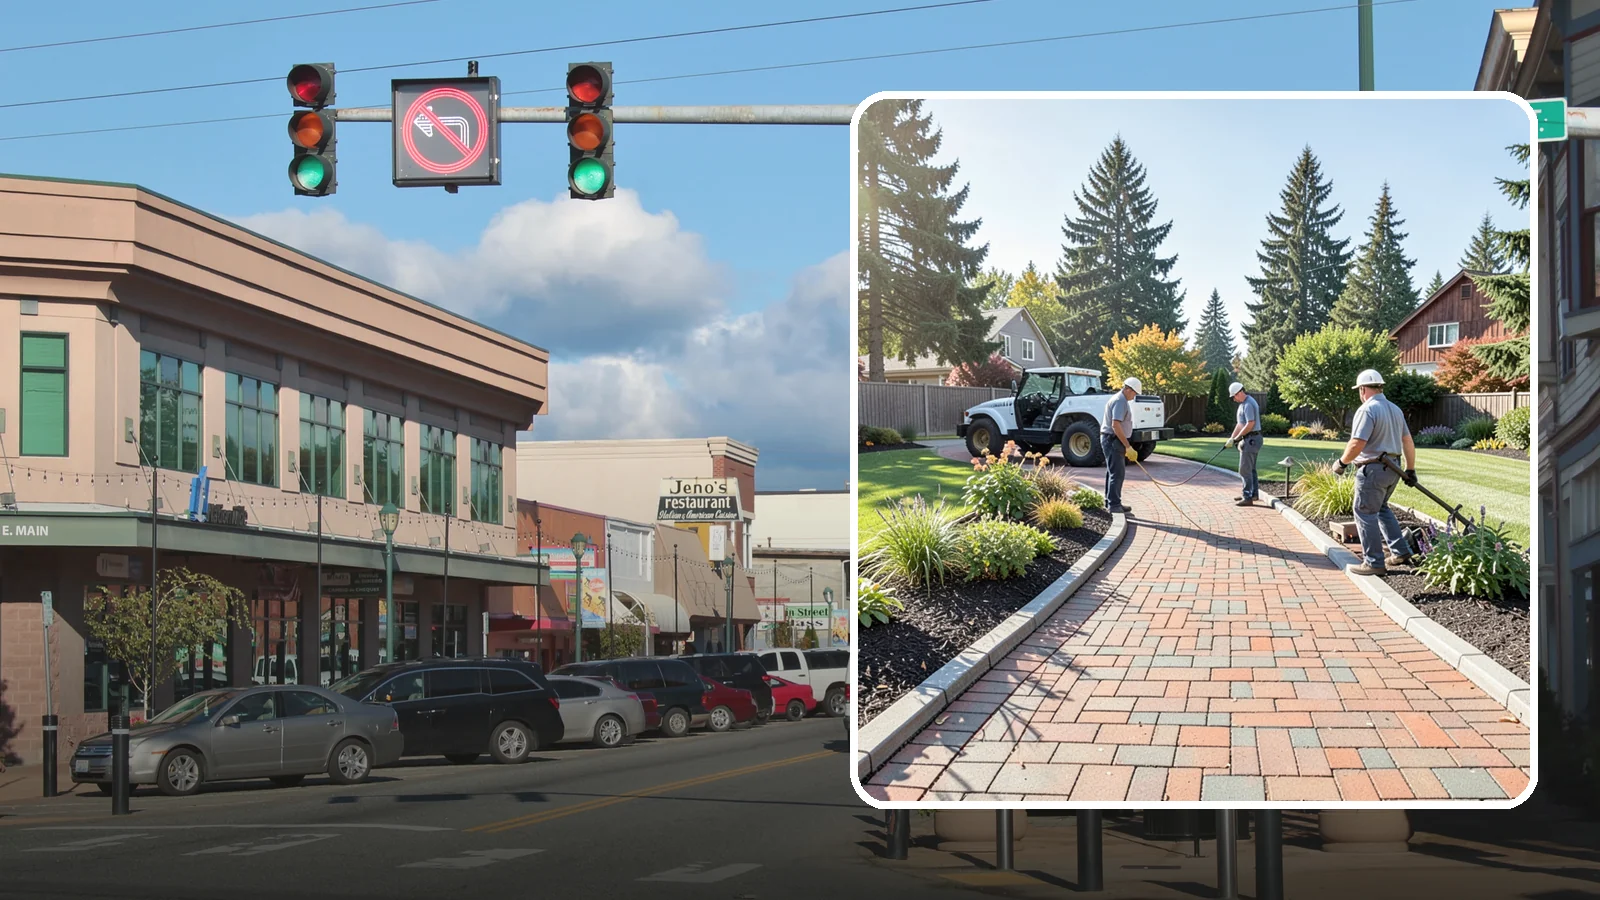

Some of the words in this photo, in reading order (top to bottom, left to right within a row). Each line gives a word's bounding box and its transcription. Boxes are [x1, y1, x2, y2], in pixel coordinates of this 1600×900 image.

[670, 480, 728, 494] Jeno's
[665, 497, 731, 509] restaurant
[658, 510, 682, 519] Italian
[686, 510, 714, 519] American
[714, 510, 737, 519] Cuisine
[2, 525, 13, 536] E.
[15, 525, 49, 536] MAIN
[797, 607, 828, 616] Street
[790, 619, 824, 627] lass
